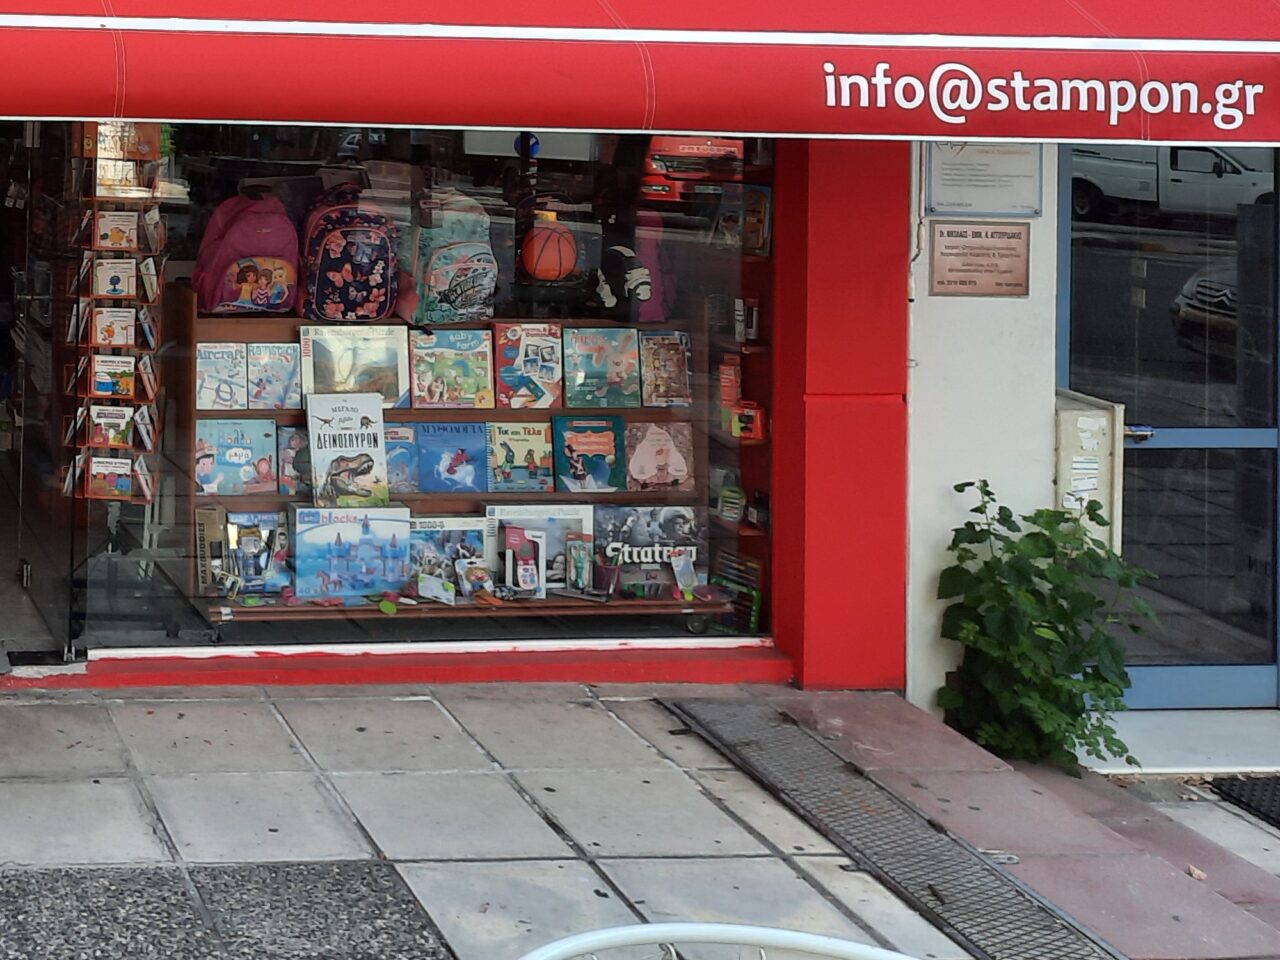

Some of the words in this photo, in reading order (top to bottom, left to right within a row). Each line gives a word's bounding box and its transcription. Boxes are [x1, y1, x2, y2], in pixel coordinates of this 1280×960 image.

[823, 62, 1265, 130] info@stampon.gr
[197, 349, 245, 360] Aircraft
[316, 432, 379, 450] ΔΕΙΝΟΣΑΥΡΩΝ
